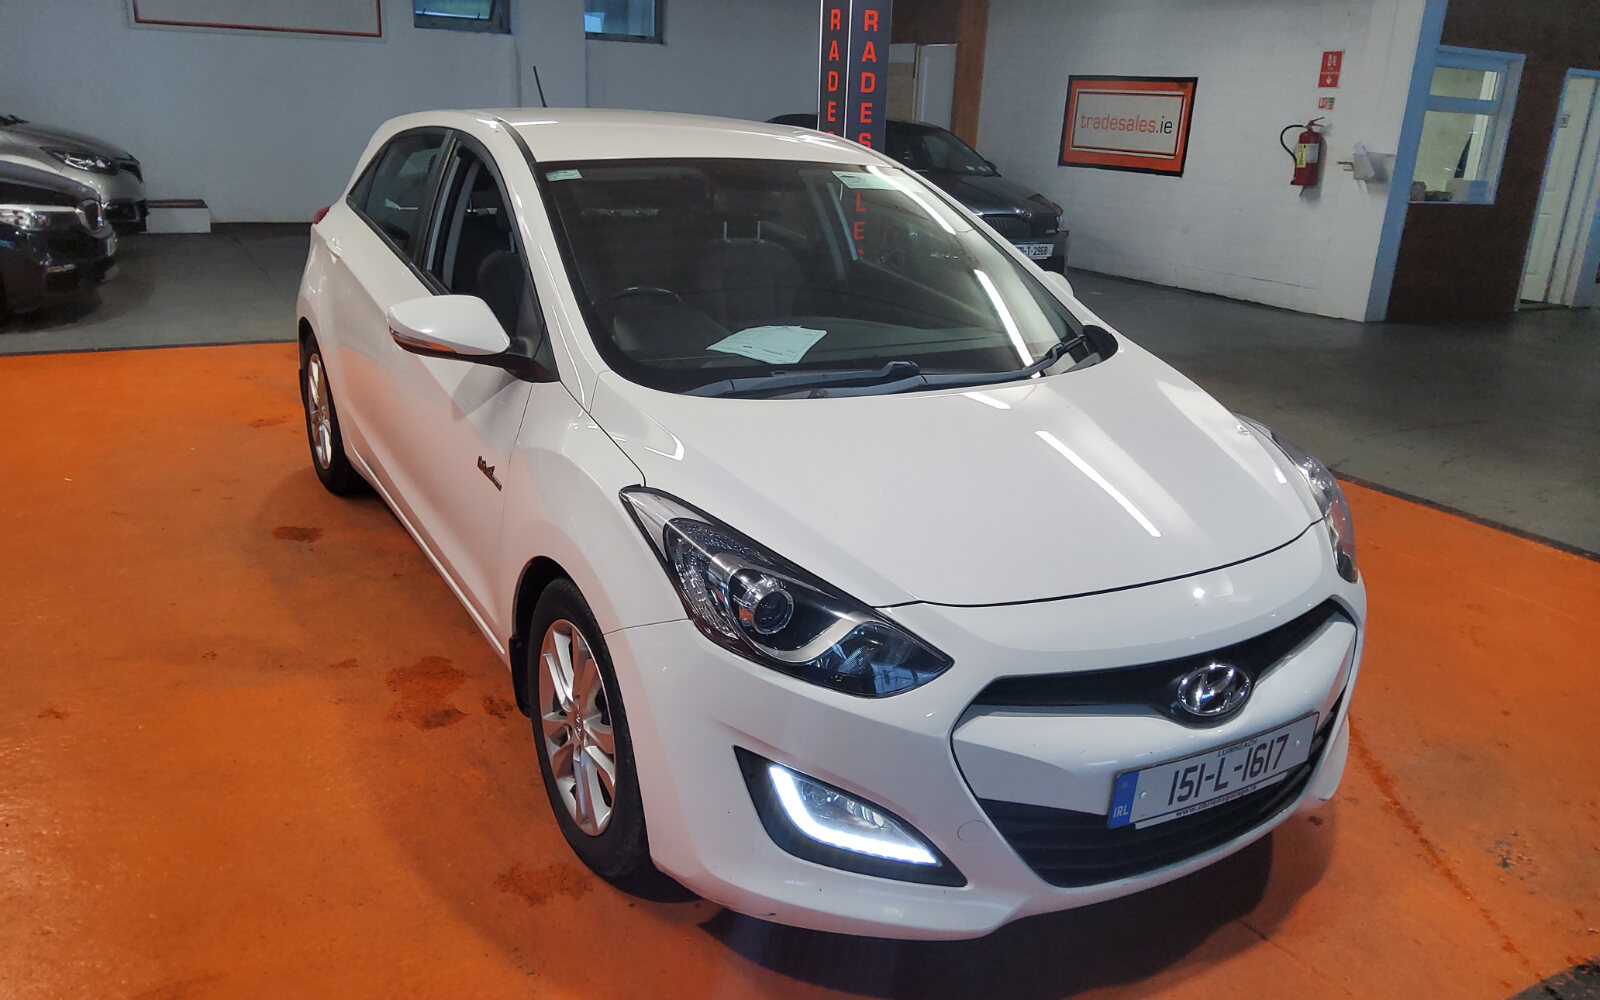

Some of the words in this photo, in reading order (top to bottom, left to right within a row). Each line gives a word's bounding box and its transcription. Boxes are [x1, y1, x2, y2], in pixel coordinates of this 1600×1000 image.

[1080, 114, 1173, 135] tradesales.ie
[1168, 733, 1290, 806] 151-L-1617
[1113, 804, 1129, 818] IRL
